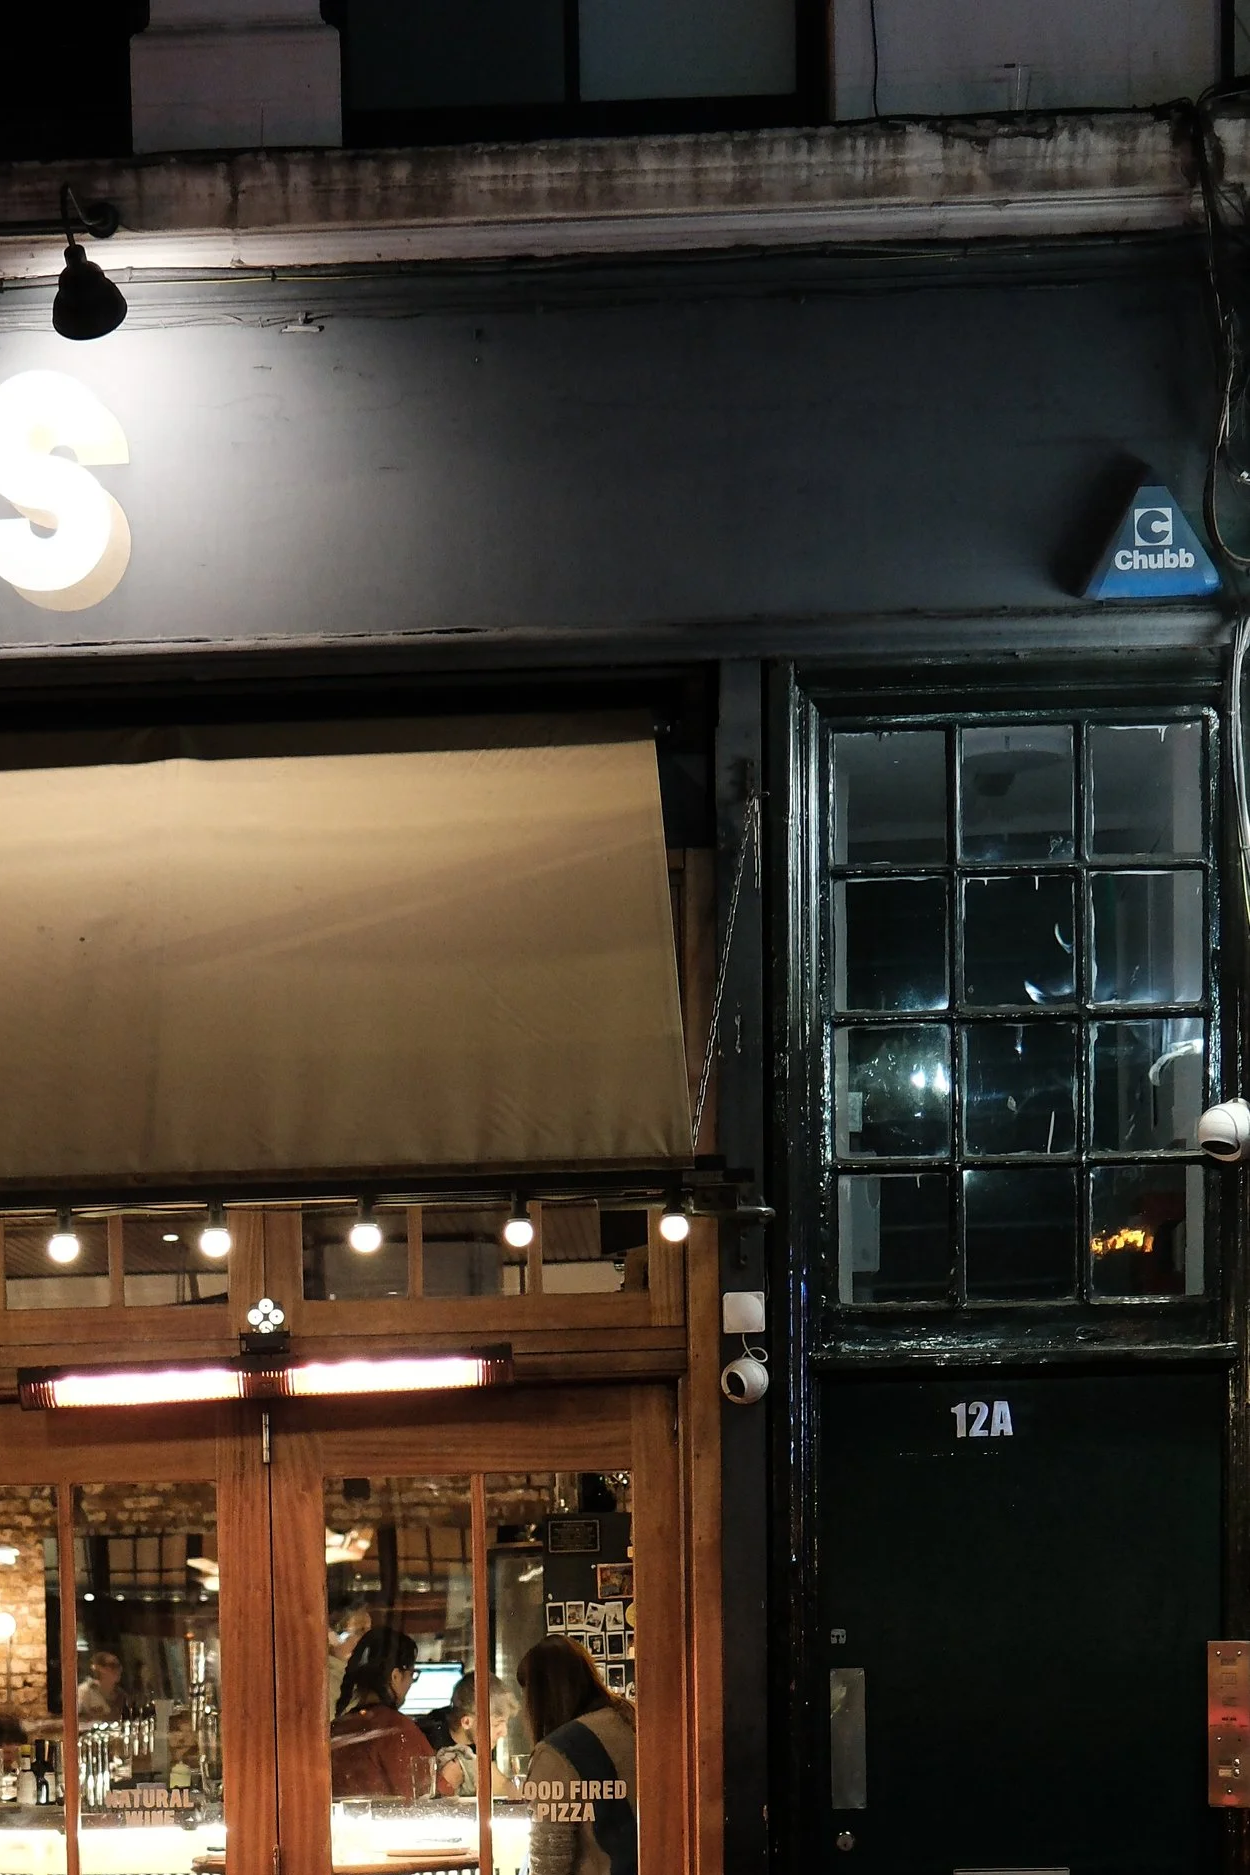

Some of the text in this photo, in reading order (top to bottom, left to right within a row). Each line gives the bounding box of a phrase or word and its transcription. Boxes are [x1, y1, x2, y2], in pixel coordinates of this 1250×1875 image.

[1114, 547, 1196, 571] Chubb
[950, 1400, 1014, 1438] 12A
[103, 1788, 195, 1808] NATURAL
[517, 1779, 628, 1801] OOD FIRED
[125, 1809, 176, 1827] WINE
[536, 1802, 596, 1823] PIZZA
